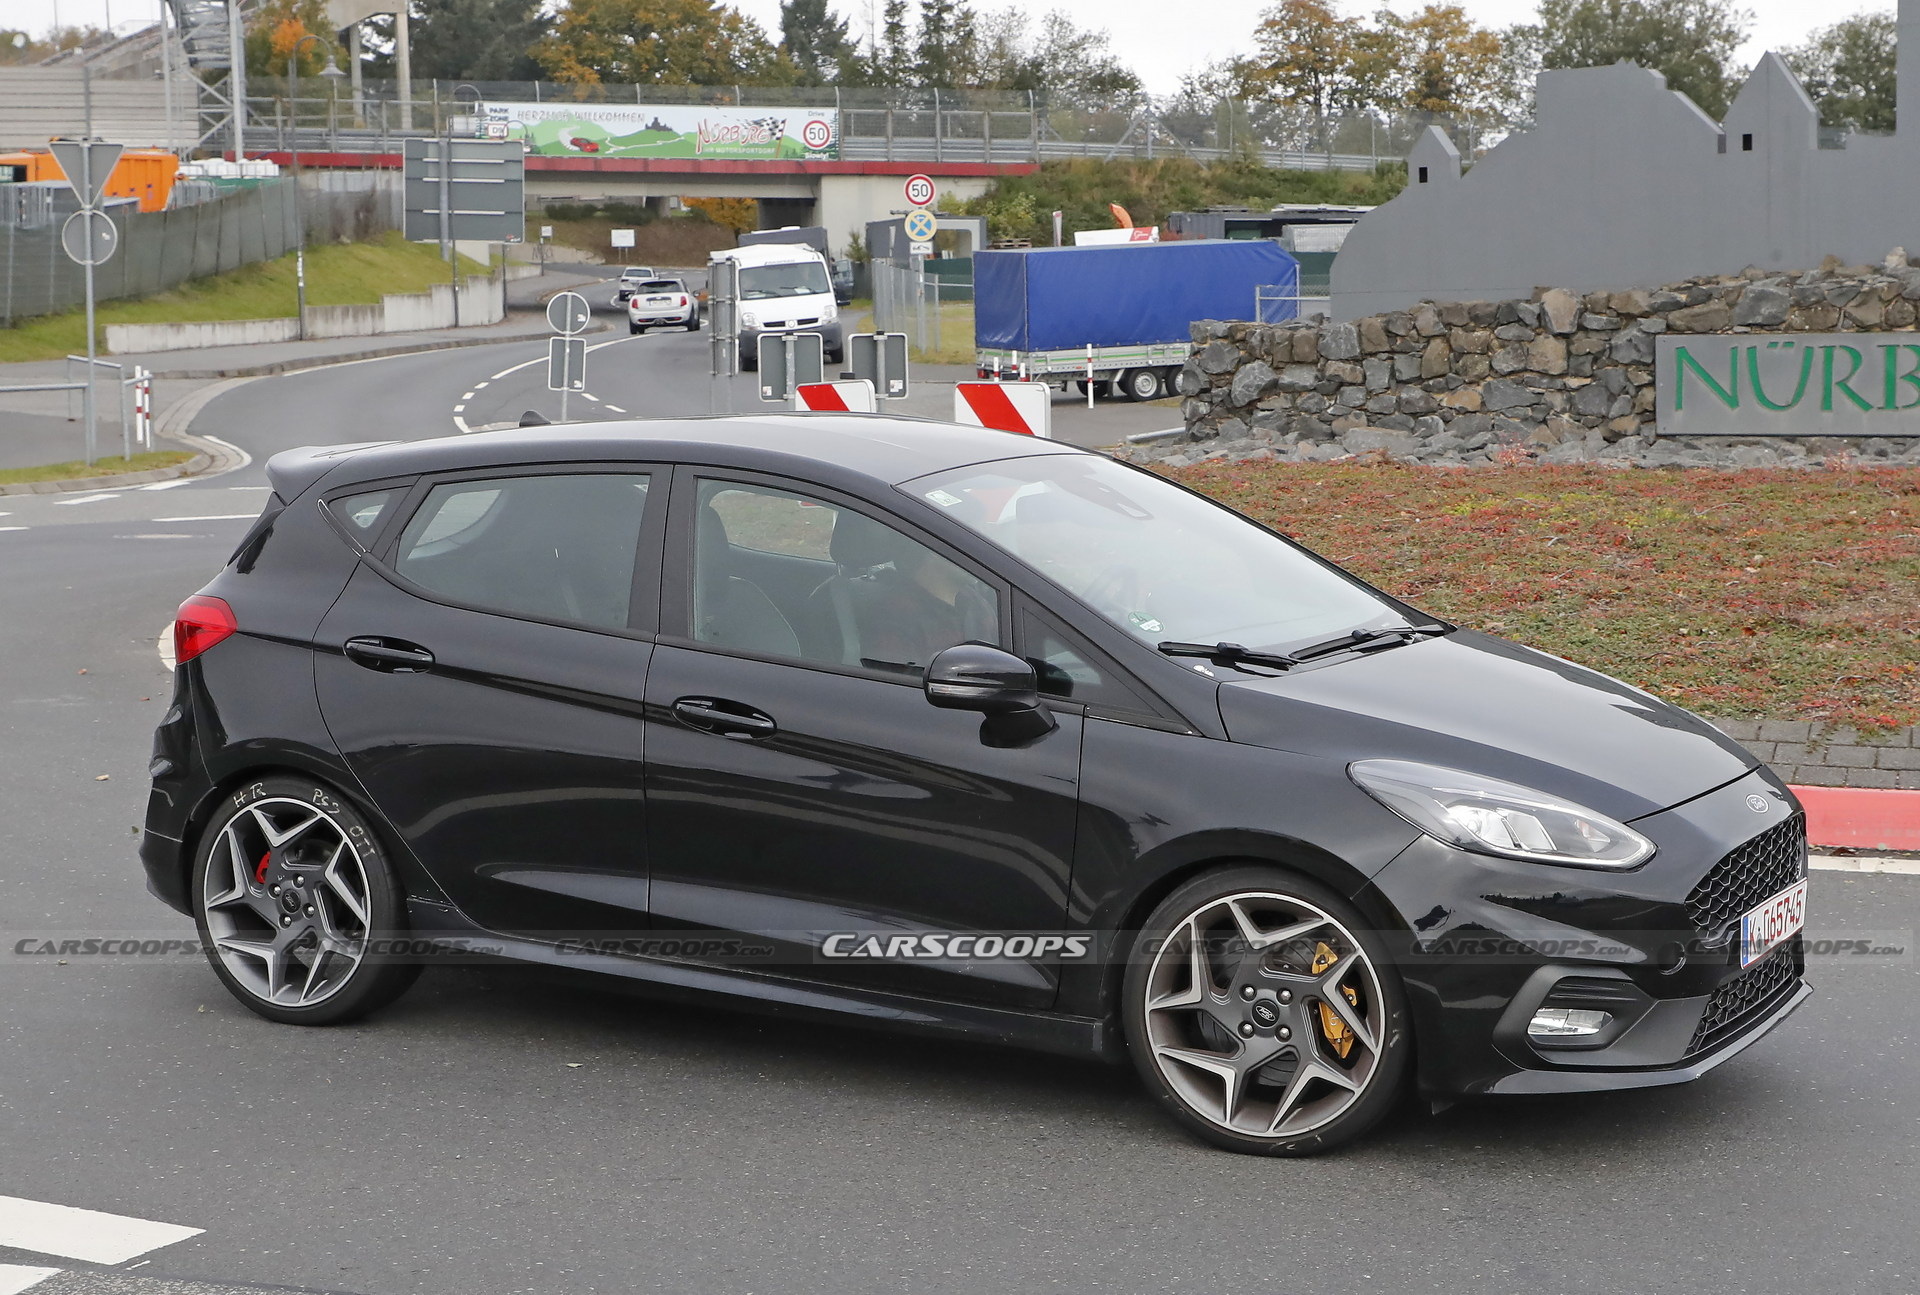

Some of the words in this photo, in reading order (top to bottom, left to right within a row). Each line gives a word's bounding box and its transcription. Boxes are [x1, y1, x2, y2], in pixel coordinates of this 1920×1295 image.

[574, 111, 645, 123] WILLKOMMEN
[809, 127, 825, 140] 50
[911, 183, 929, 198] 50
[1675, 341, 1920, 412] NÜRB
[1749, 915, 1758, 955] K
